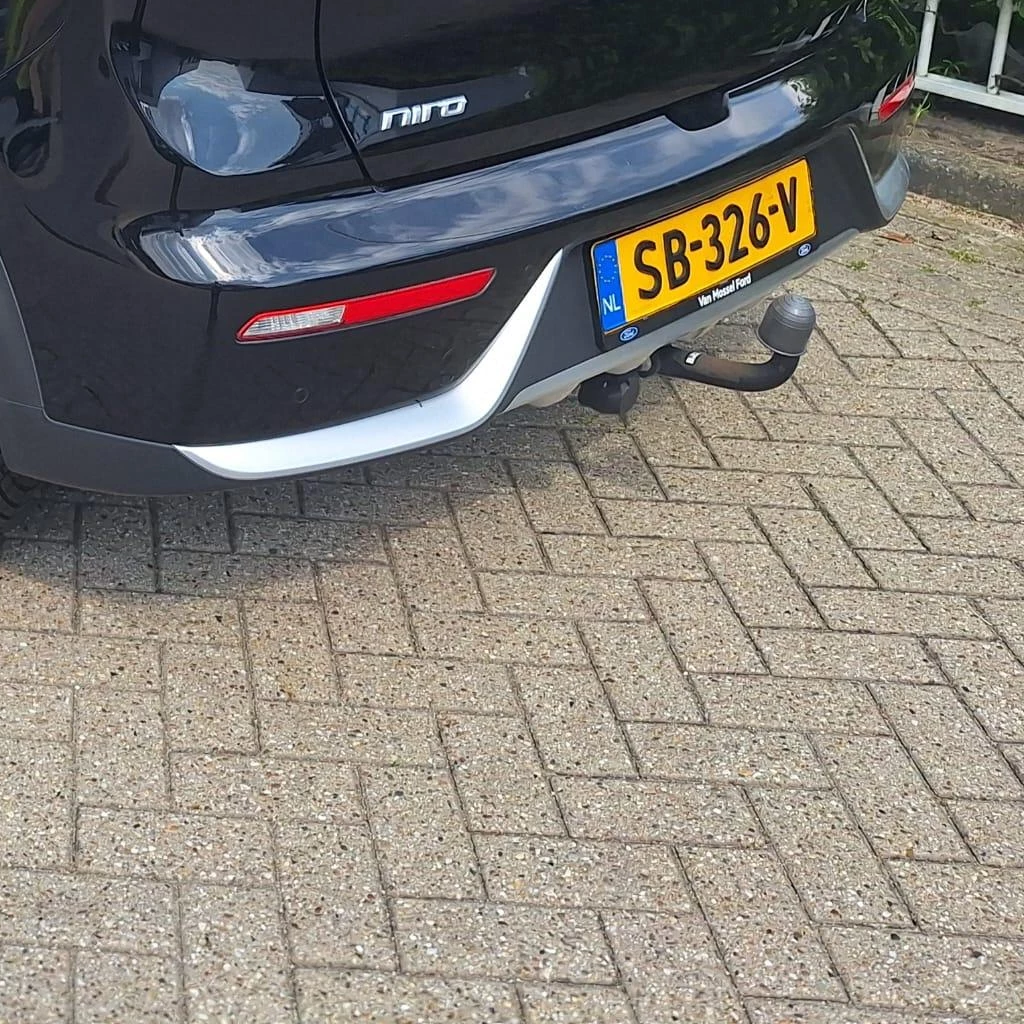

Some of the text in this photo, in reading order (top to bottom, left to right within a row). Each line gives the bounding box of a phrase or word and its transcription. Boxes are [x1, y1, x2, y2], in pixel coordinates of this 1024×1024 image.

[633, 176, 797, 300] SB-326-V
[602, 293, 621, 315] NL
[697, 272, 752, 307] Van Mossel Ford
